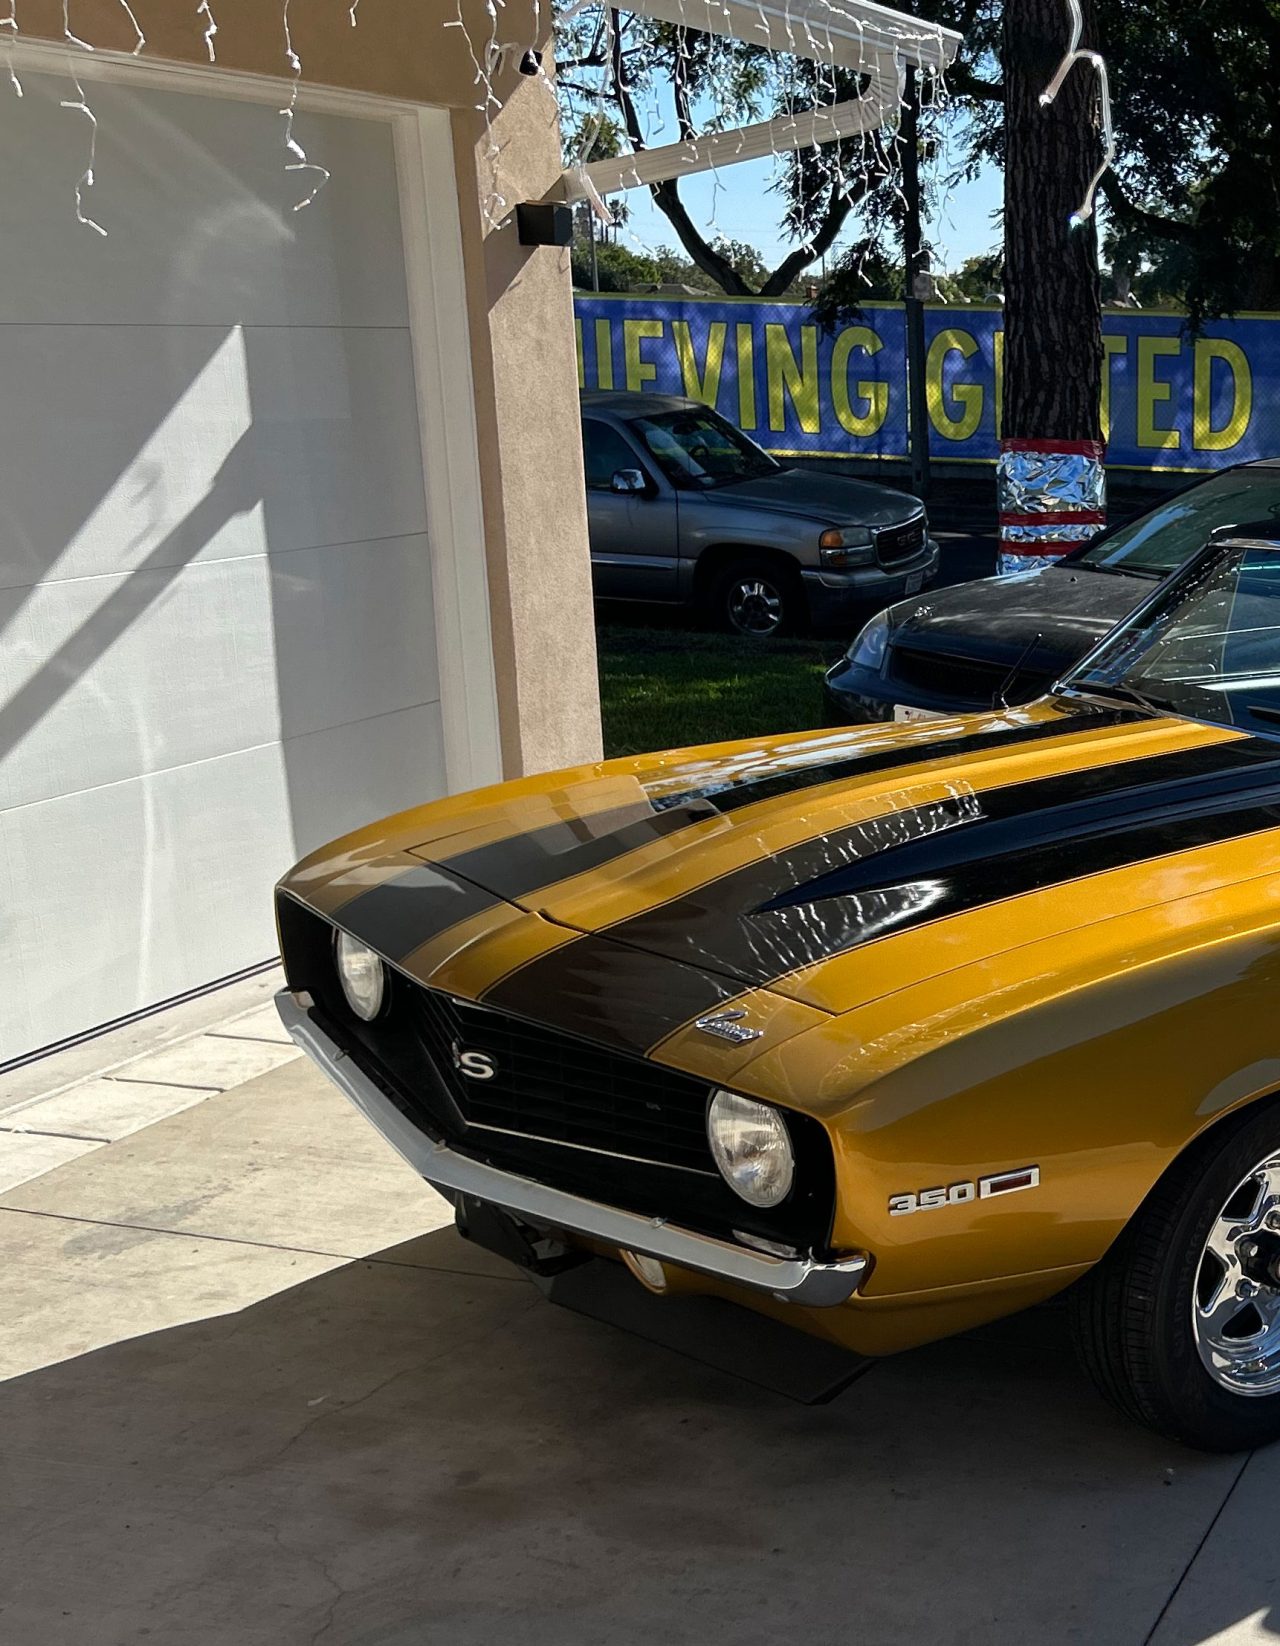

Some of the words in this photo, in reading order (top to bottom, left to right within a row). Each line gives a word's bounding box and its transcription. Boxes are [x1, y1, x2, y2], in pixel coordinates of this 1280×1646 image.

[573, 317, 890, 438] IEVING
[925, 328, 1253, 452] GTED
[889, 1181, 976, 1217] 350
